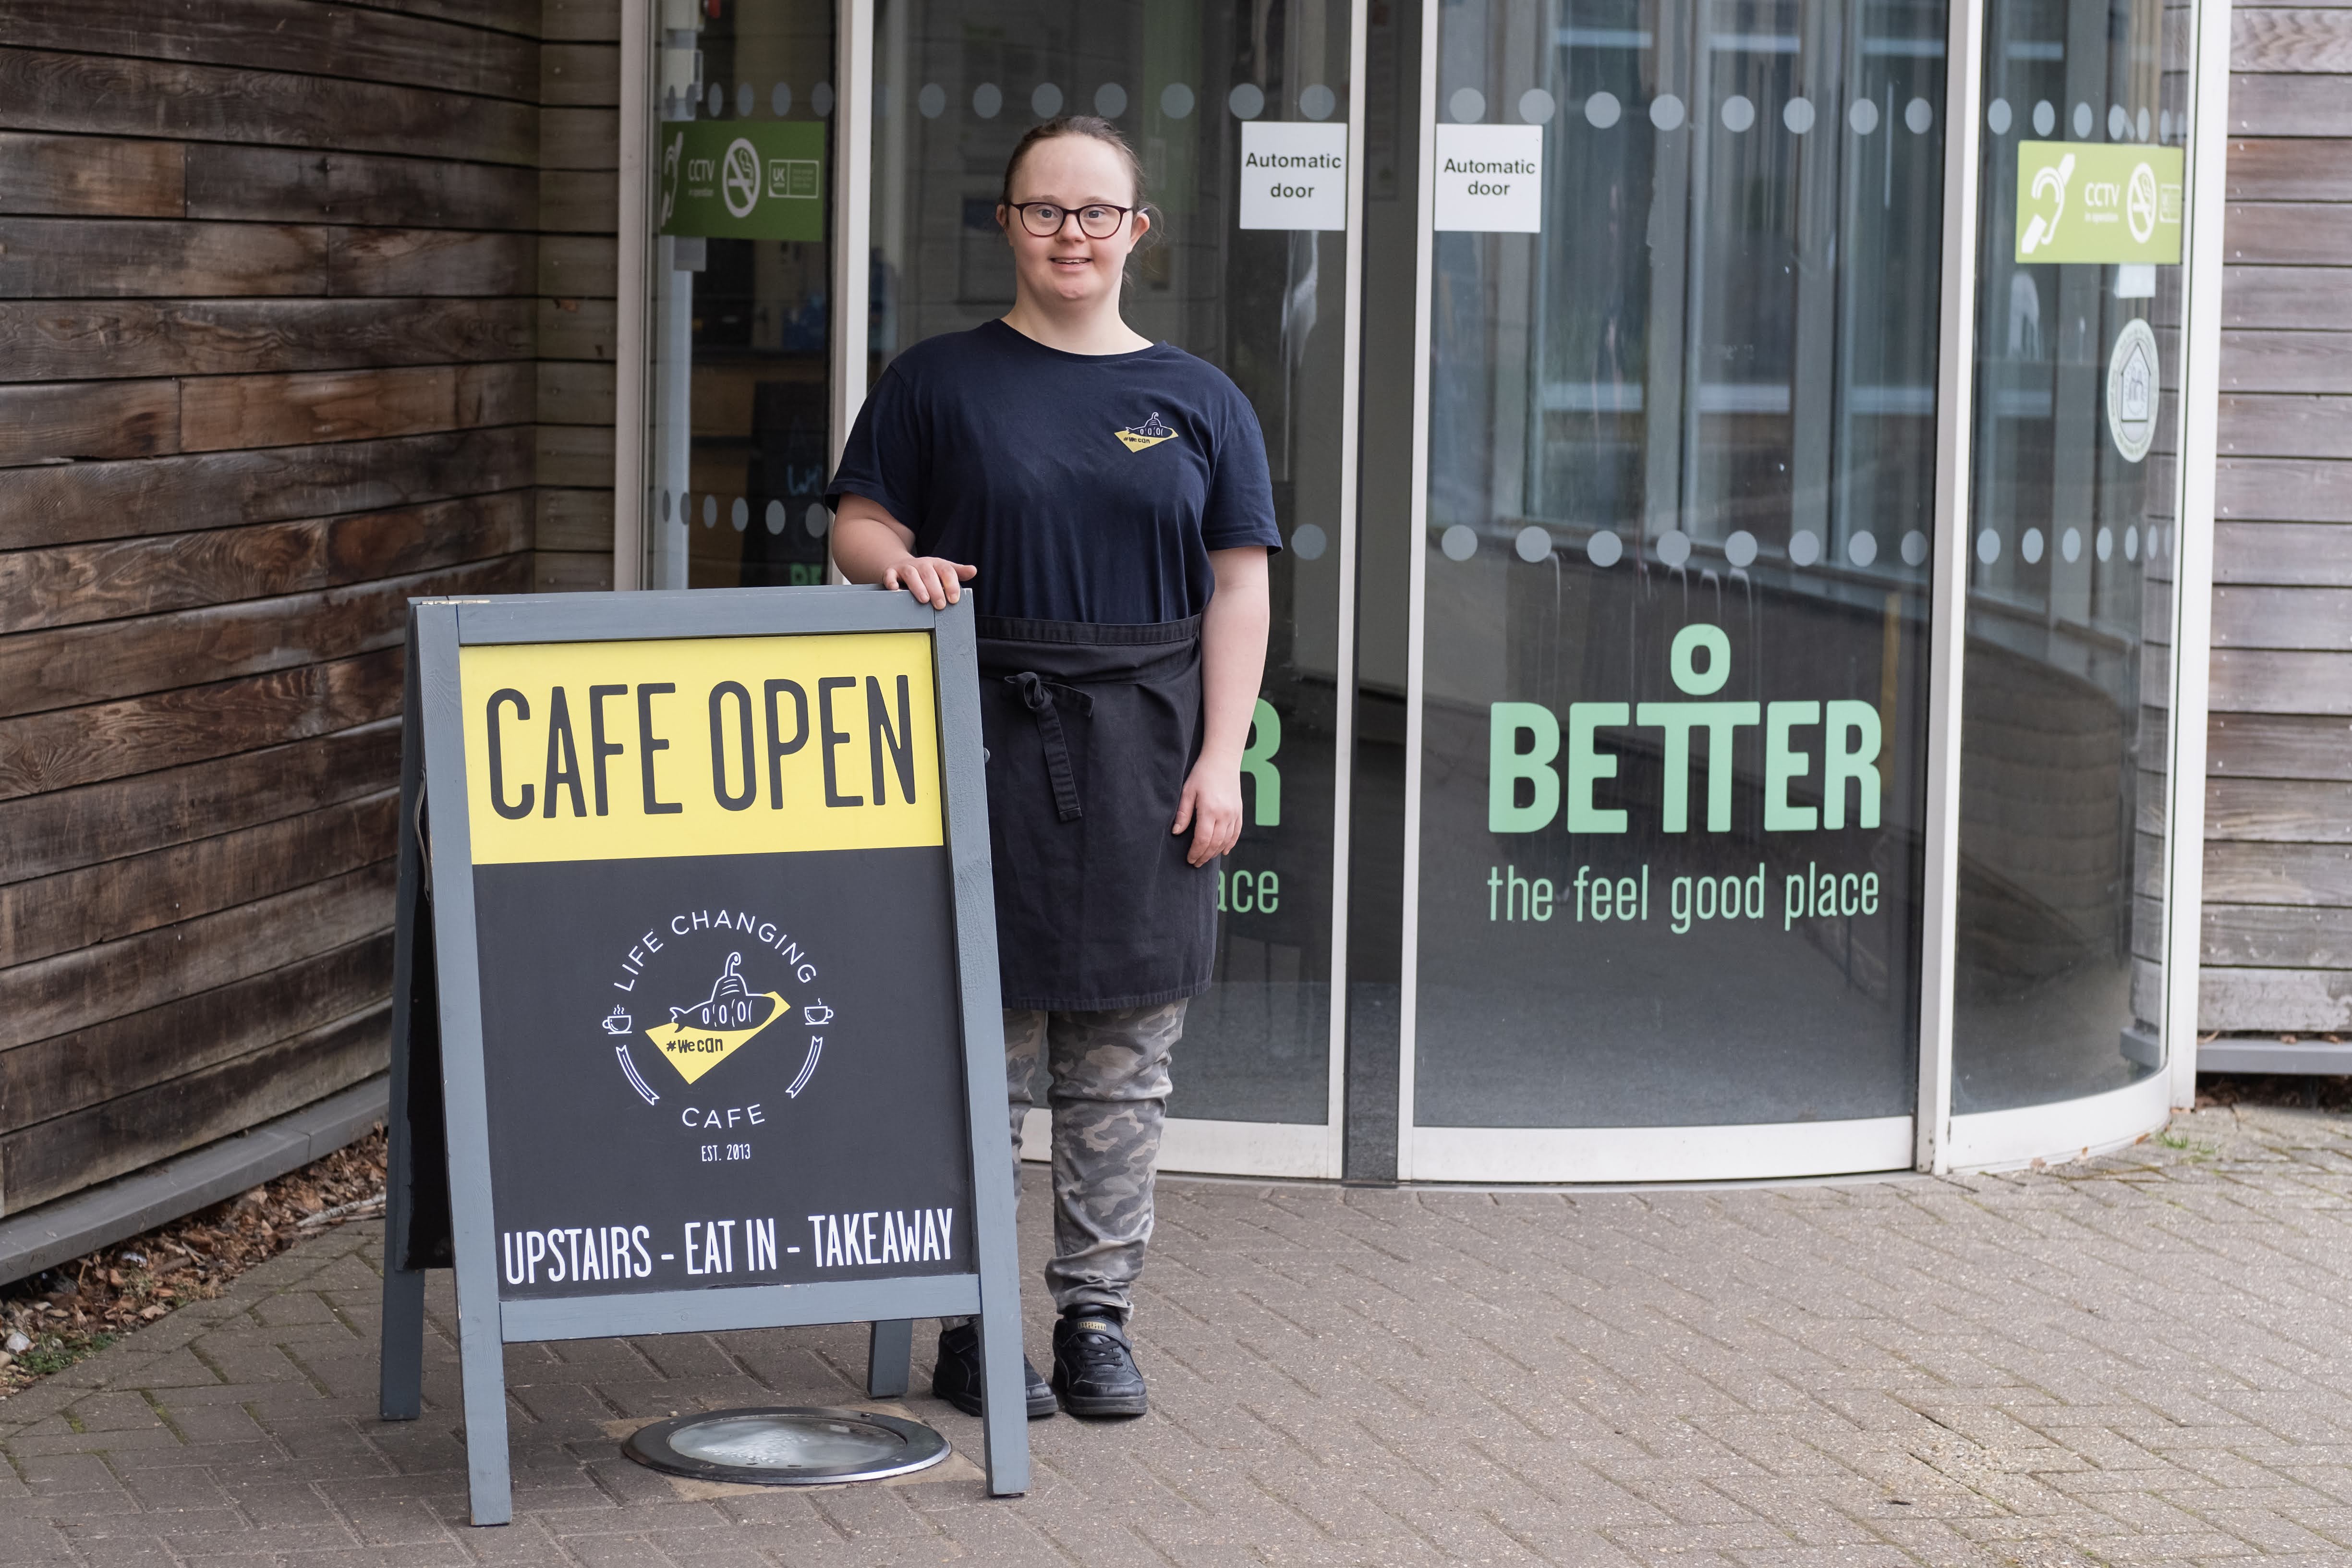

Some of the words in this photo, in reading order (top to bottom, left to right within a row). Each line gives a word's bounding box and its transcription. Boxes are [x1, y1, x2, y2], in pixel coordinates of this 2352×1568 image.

[688, 159, 715, 182] CCTV
[1246, 152, 1342, 169] Automatic
[1444, 158, 1536, 174] Automatic
[1270, 182, 1314, 198] door
[1467, 180, 1510, 195] door
[2084, 182, 2121, 207] CCTV
[486, 683, 682, 819] CAFE
[709, 675, 915, 811] OPEN
[1489, 700, 1881, 833] BETTER
[1487, 865, 1553, 922] the
[1573, 864, 1649, 923] feel
[1671, 863, 1765, 934] good
[1784, 861, 1879, 931] place
[614, 931, 664, 991] LIFE
[671, 910, 816, 984] CHANGING
[682, 1104, 765, 1129] CAFE
[701, 1145, 722, 1162] EST.
[727, 1143, 751, 1160] 2013
[504, 1225, 652, 1285] UPSTAIRS
[685, 1220, 736, 1275] EAT
[746, 1218, 776, 1271] IN
[808, 1208, 953, 1267] TAKEAWAY
